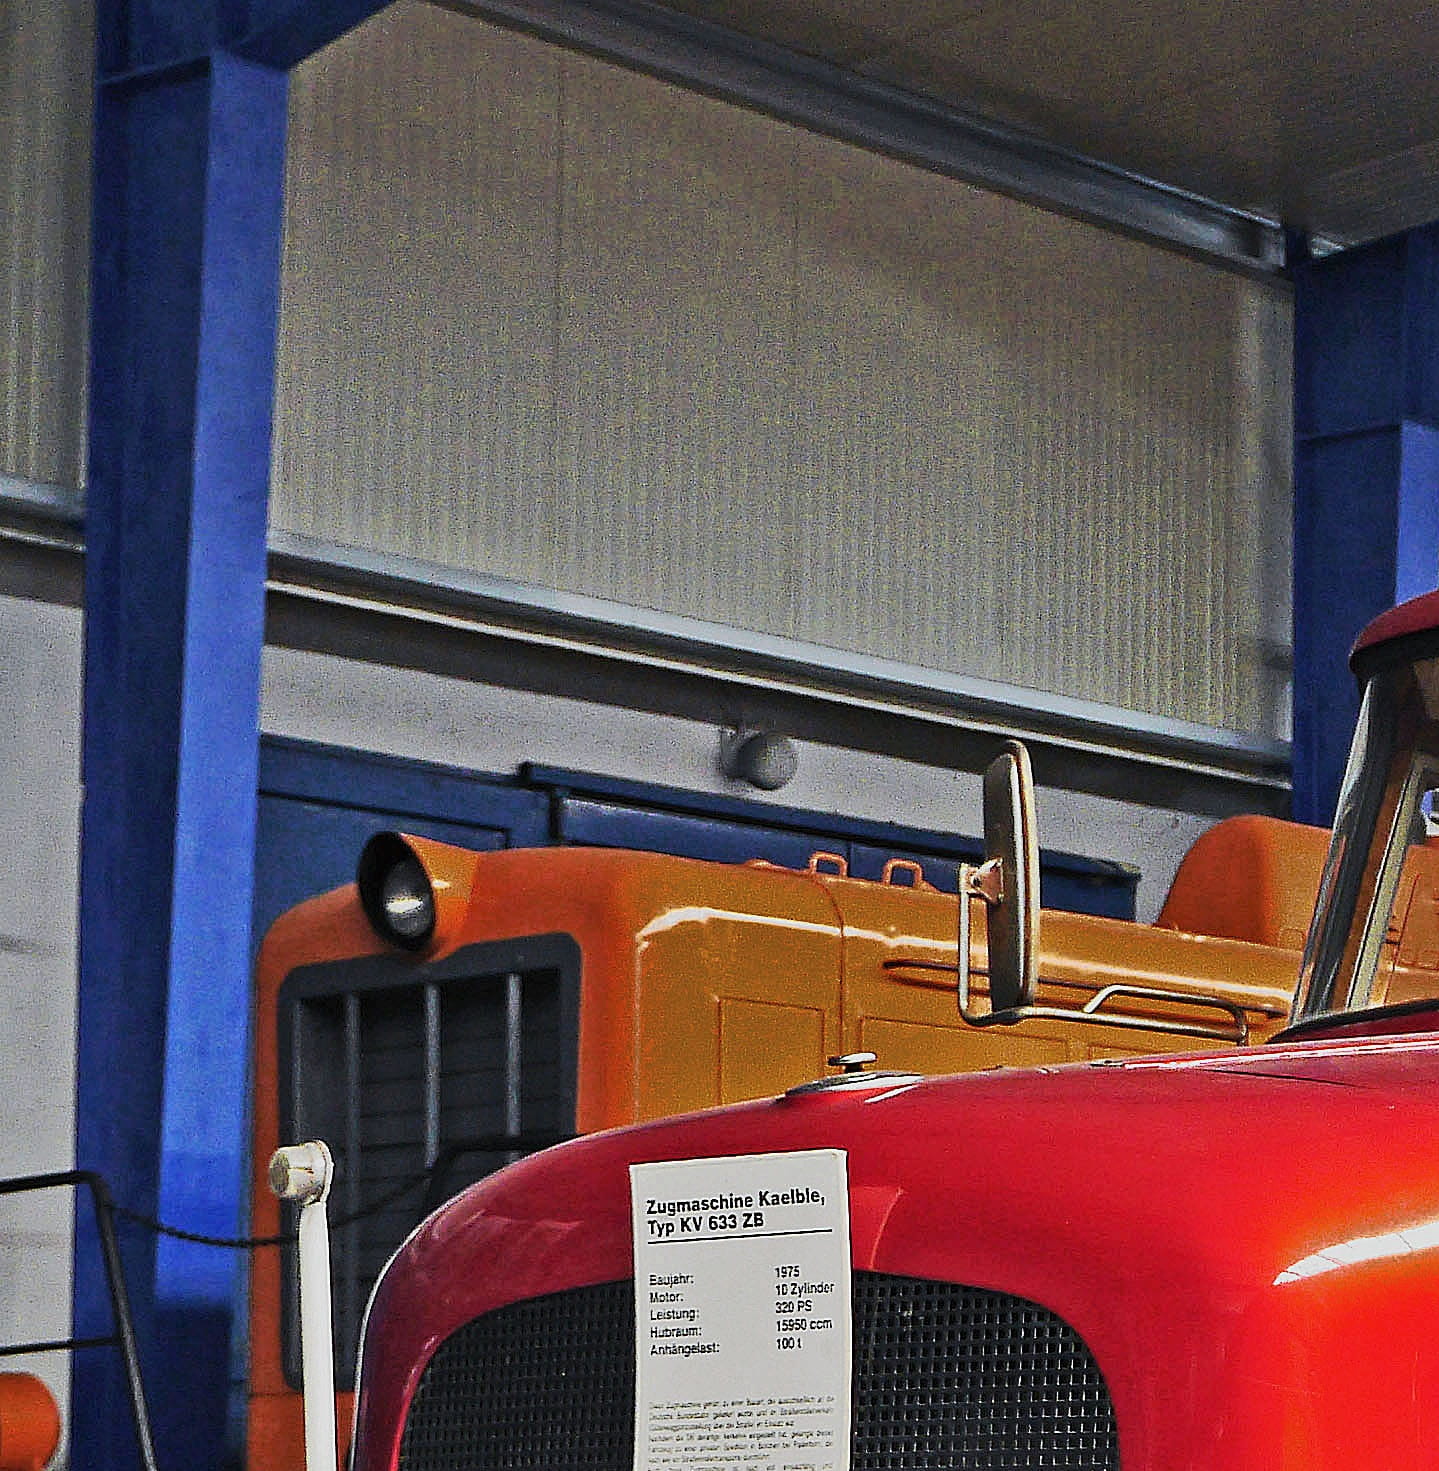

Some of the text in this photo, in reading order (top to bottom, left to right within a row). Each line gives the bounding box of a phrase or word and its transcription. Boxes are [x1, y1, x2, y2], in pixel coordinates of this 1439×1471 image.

[646, 1187, 826, 1217] Zugmaschine Kaelble,
[647, 1211, 765, 1238] Typ KV 633 ZB
[774, 1265, 800, 1278] 1975
[649, 1273, 695, 1289] Baujahr:
[775, 1281, 835, 1298] 10 Zylinder
[775, 1299, 813, 1314] 320 PS
[649, 1308, 700, 1322] Leistung:
[649, 1326, 703, 1338] Hubraum:
[776, 1318, 833, 1332] 15950 ccm
[650, 1341, 721, 1358] Anhängelast:
[776, 1337, 795, 1350] 100
